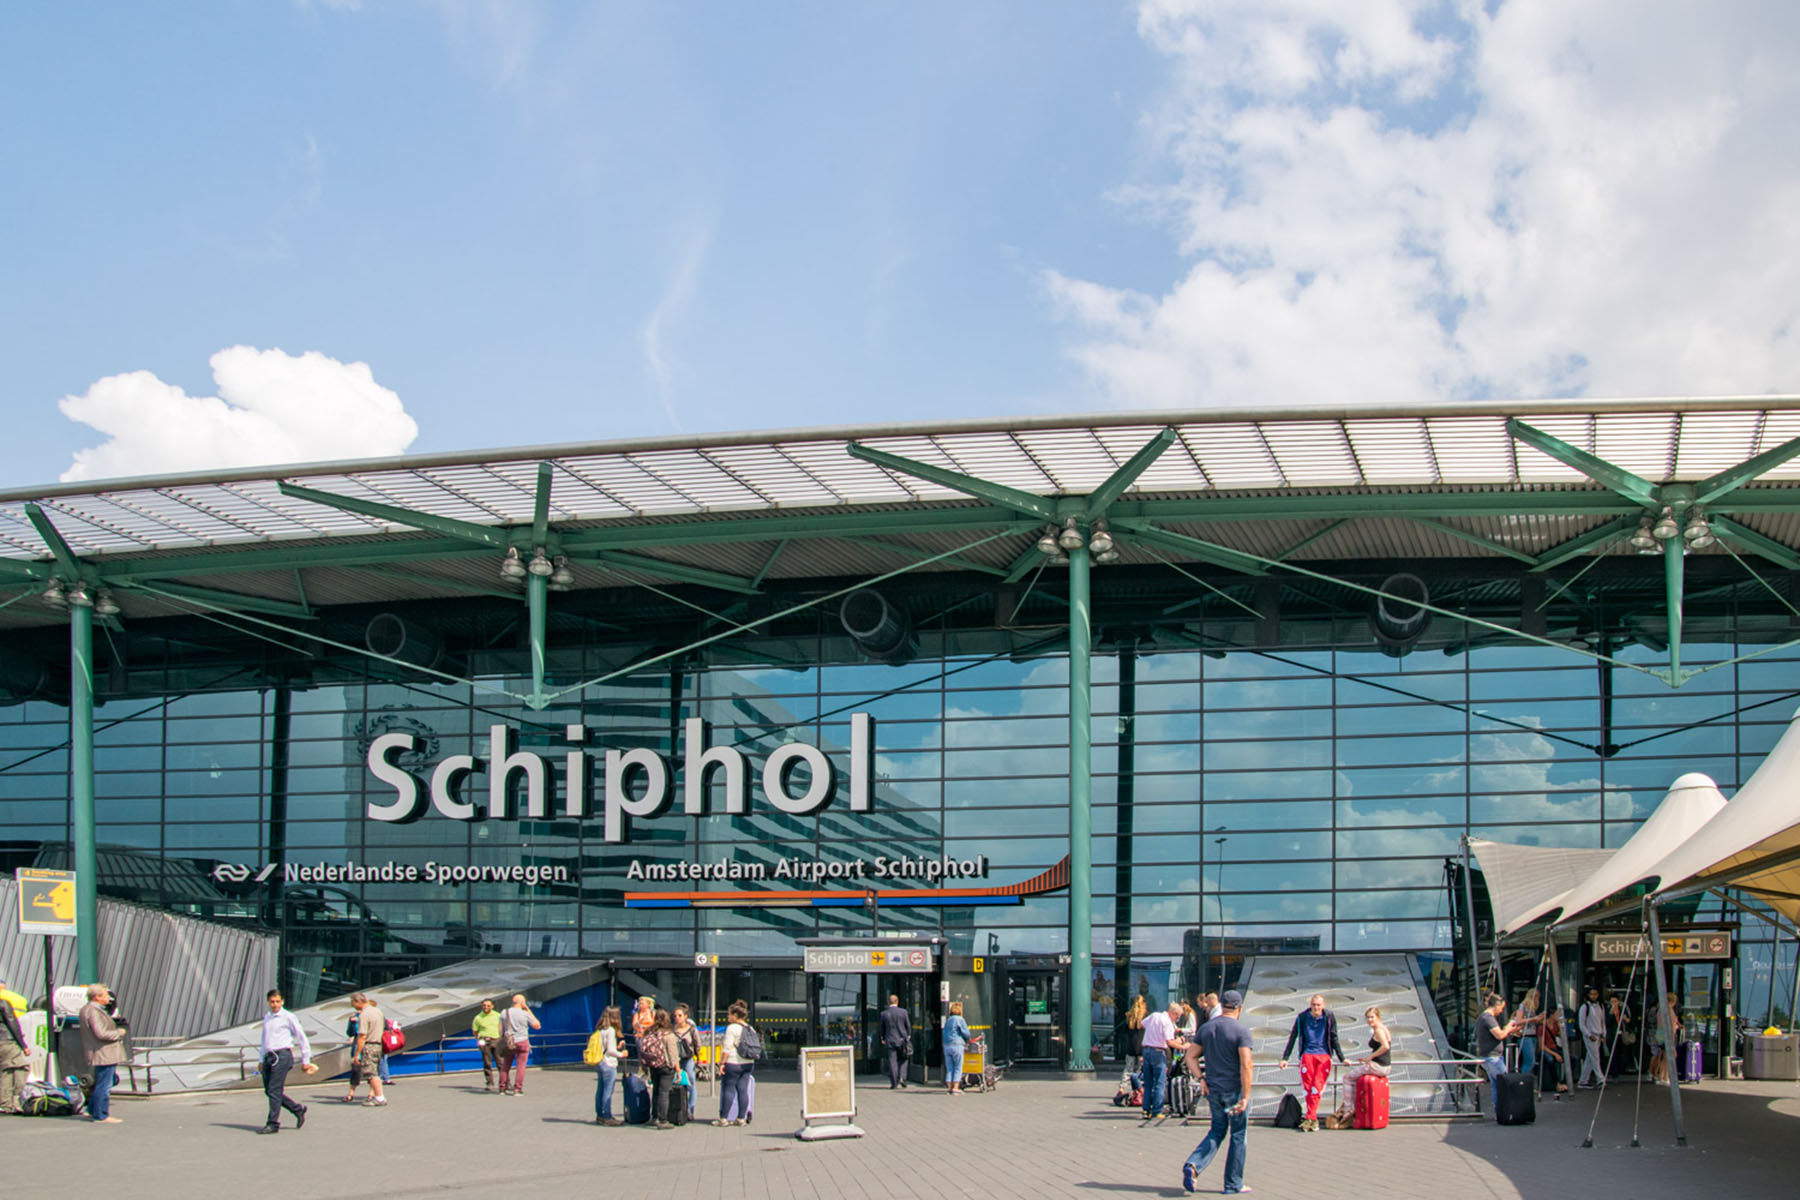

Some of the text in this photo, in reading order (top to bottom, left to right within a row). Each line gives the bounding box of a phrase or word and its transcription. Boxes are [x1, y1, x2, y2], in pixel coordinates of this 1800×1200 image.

[367, 713, 872, 842] Schiphol
[284, 860, 567, 886] Nederlandse Spoorwegen
[626, 854, 983, 882] Amsterdam Airport Schiphol
[809, 951, 868, 967] Schiphol
[975, 960, 983, 971] D
